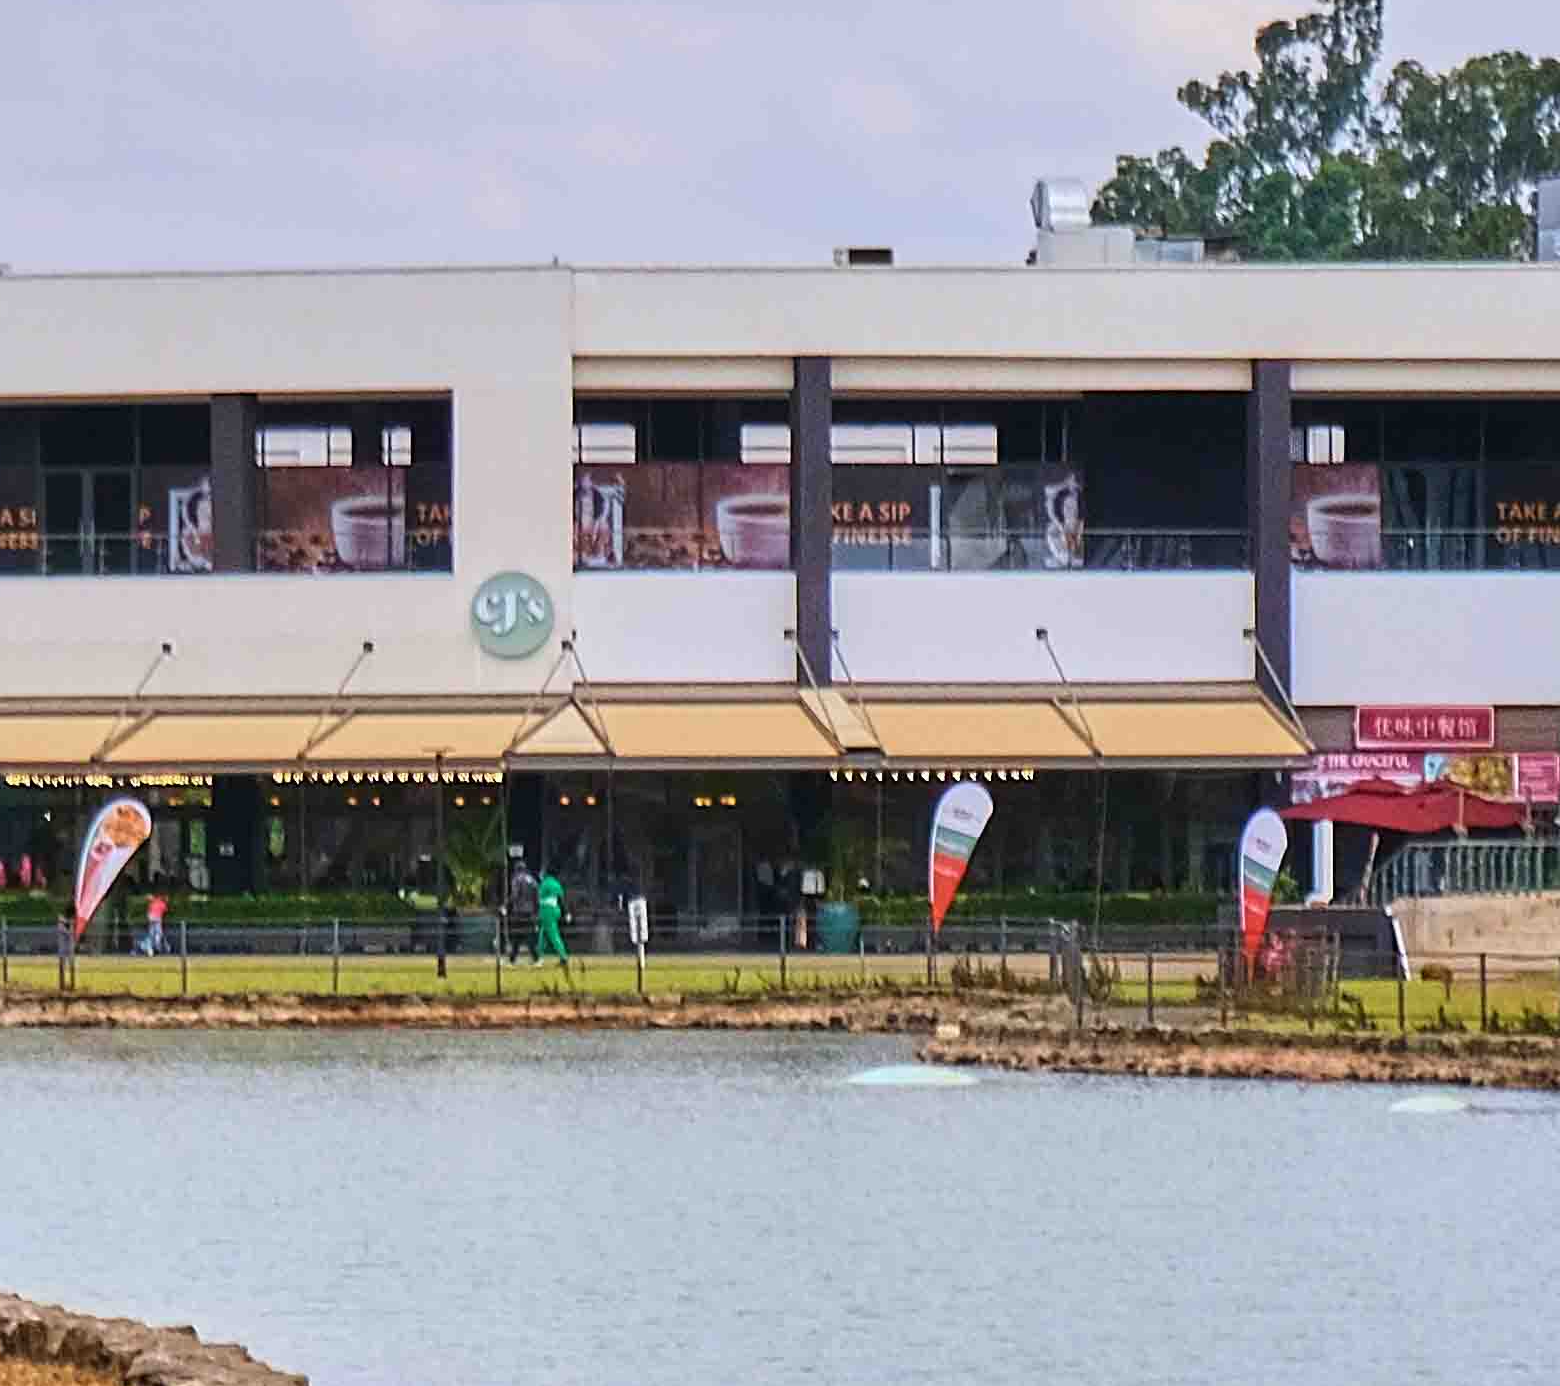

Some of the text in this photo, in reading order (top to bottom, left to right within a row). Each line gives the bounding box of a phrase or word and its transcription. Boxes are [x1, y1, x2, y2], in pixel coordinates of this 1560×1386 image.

[859, 501, 872, 522] A
[880, 501, 911, 522] SIP
[1496, 502, 1547, 520] TAKE
[1496, 526, 1522, 545] OF
